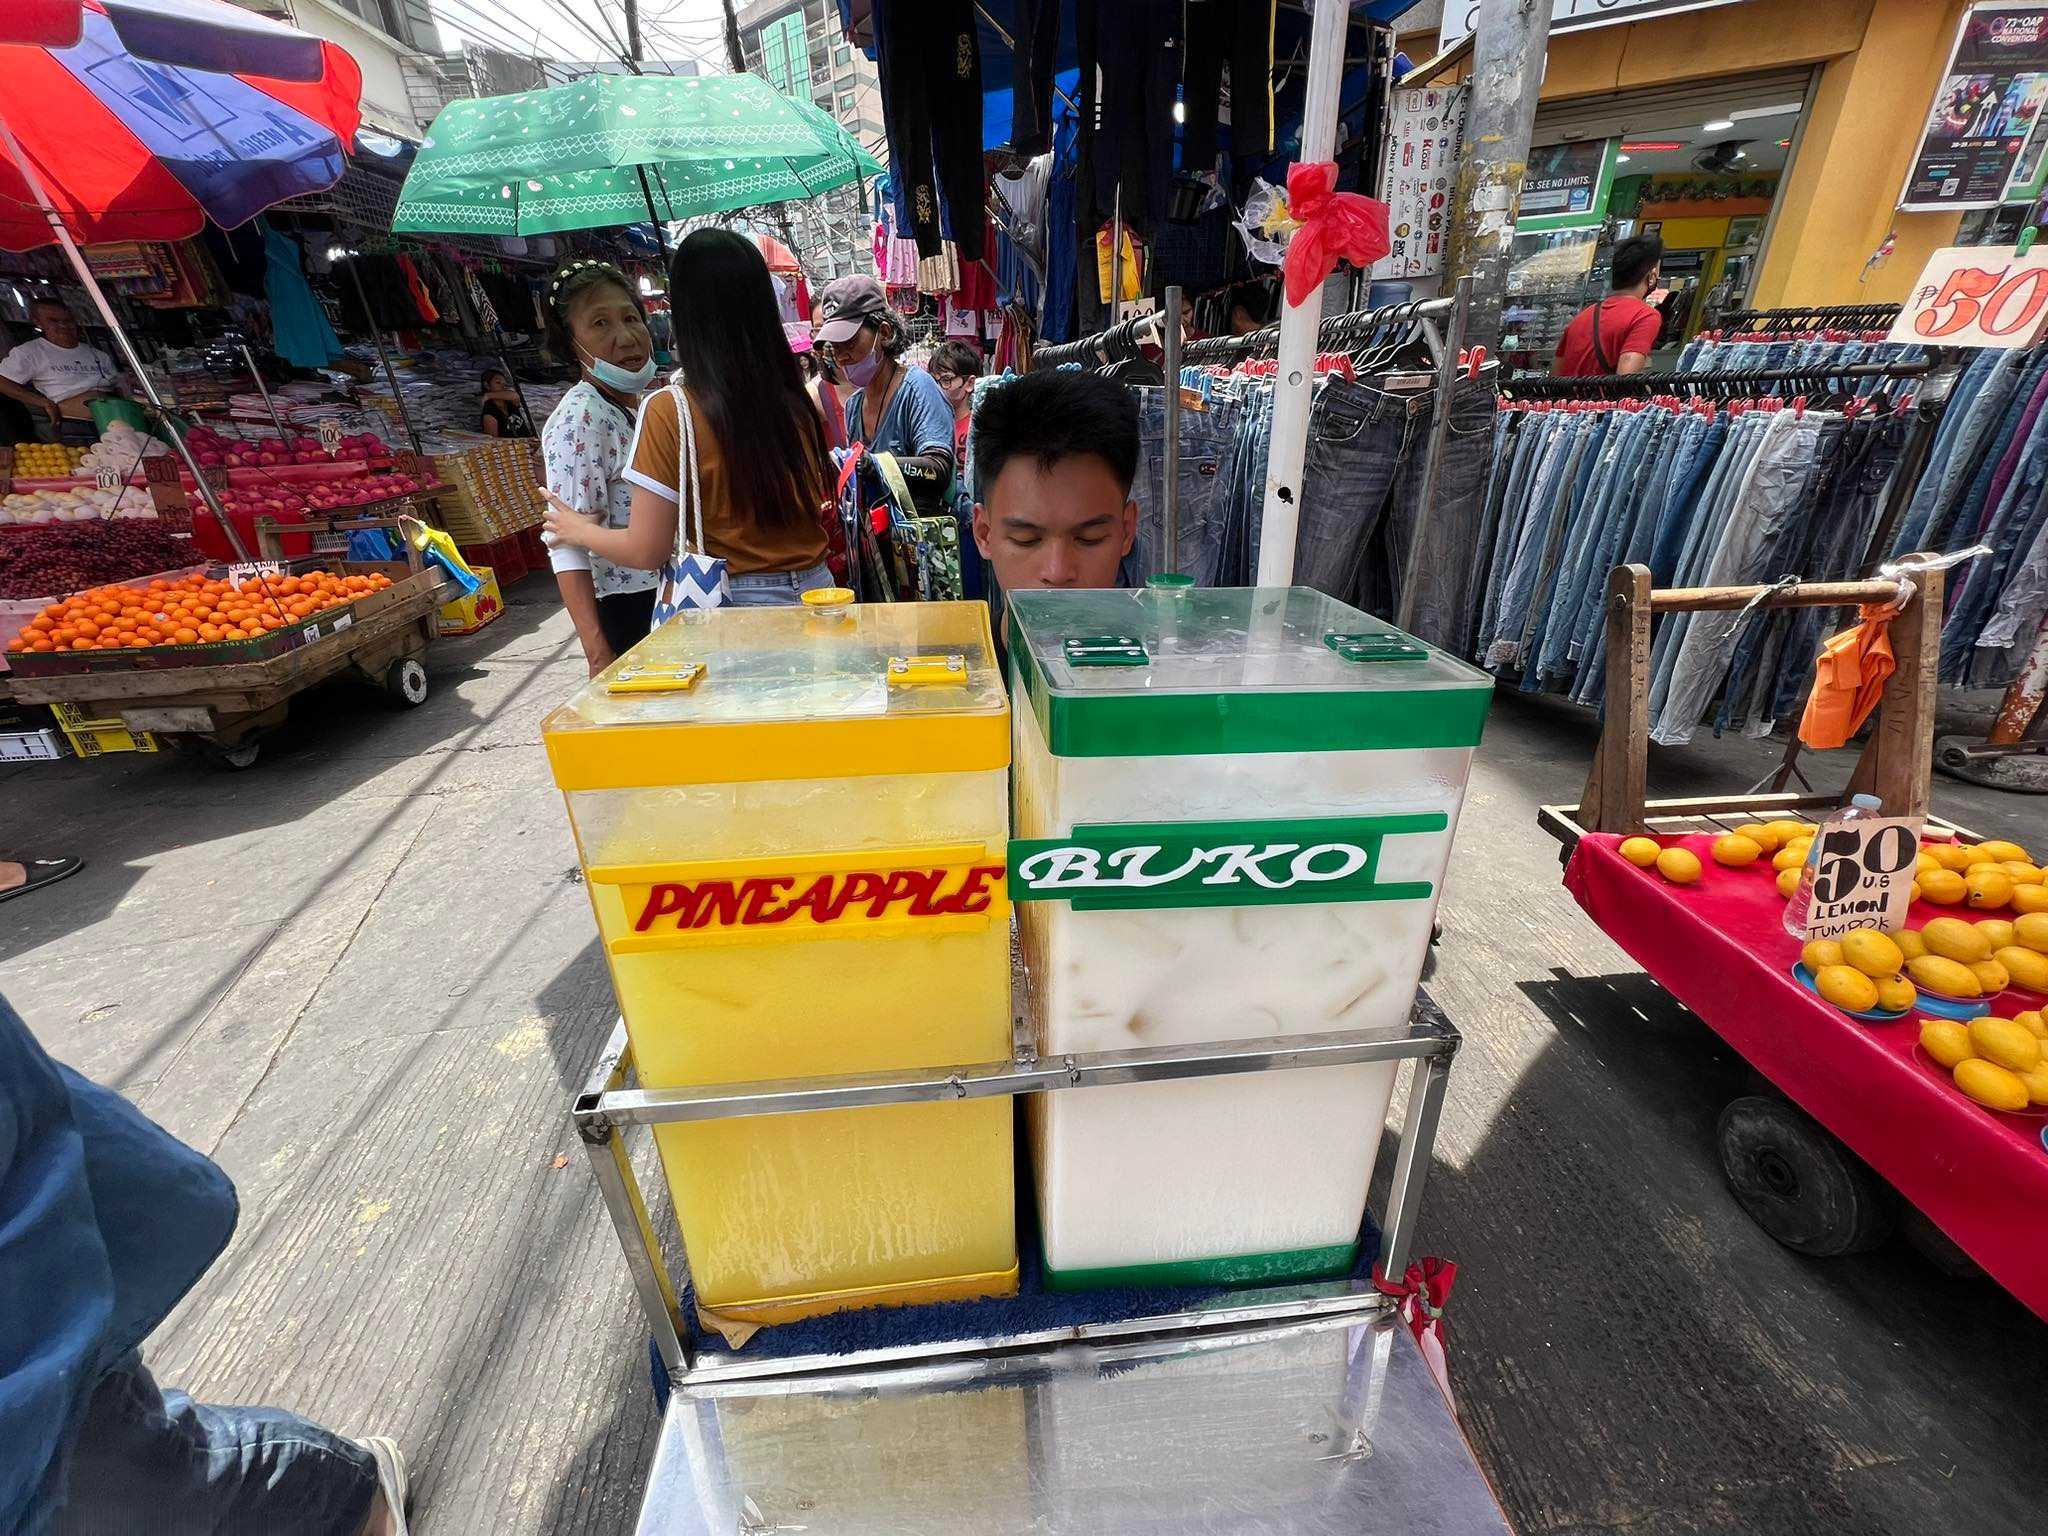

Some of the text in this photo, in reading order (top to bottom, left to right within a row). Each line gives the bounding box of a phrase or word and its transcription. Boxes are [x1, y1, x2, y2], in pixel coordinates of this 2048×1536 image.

[1991, 34, 2038, 43] CONVENTION
[1537, 179, 1550, 189] SEE
[1552, 178, 1563, 187] NO
[1563, 175, 1591, 186] LIMITS.
[1019, 842, 1368, 890] BUKO
[1813, 825, 1917, 904] 50
[636, 865, 1005, 932] PINEAPPLE
[1814, 892, 1889, 920] LEMON
